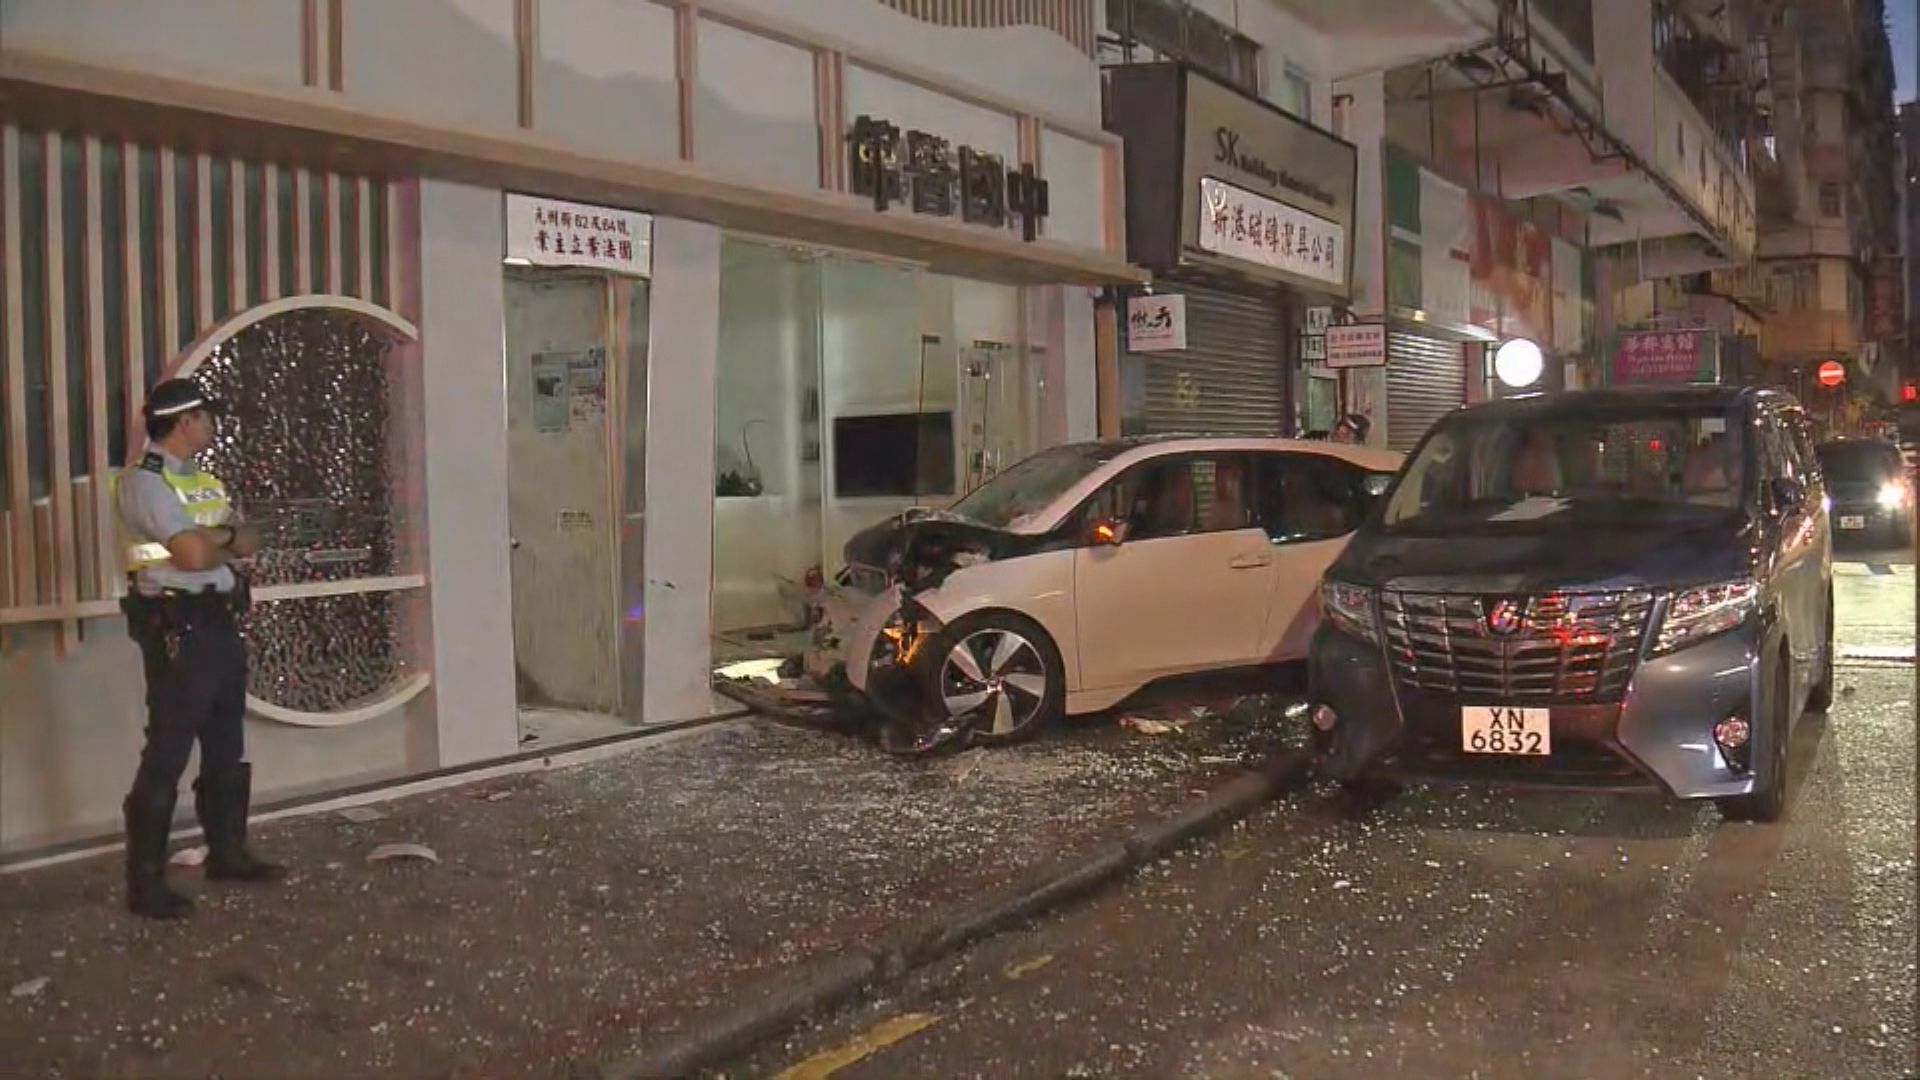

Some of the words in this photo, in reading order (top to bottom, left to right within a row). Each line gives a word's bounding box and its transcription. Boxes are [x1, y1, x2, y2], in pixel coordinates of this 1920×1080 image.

[1215, 127, 1239, 167] SK
[1489, 708, 1524, 730] XN
[1471, 728, 1542, 753] 6832
